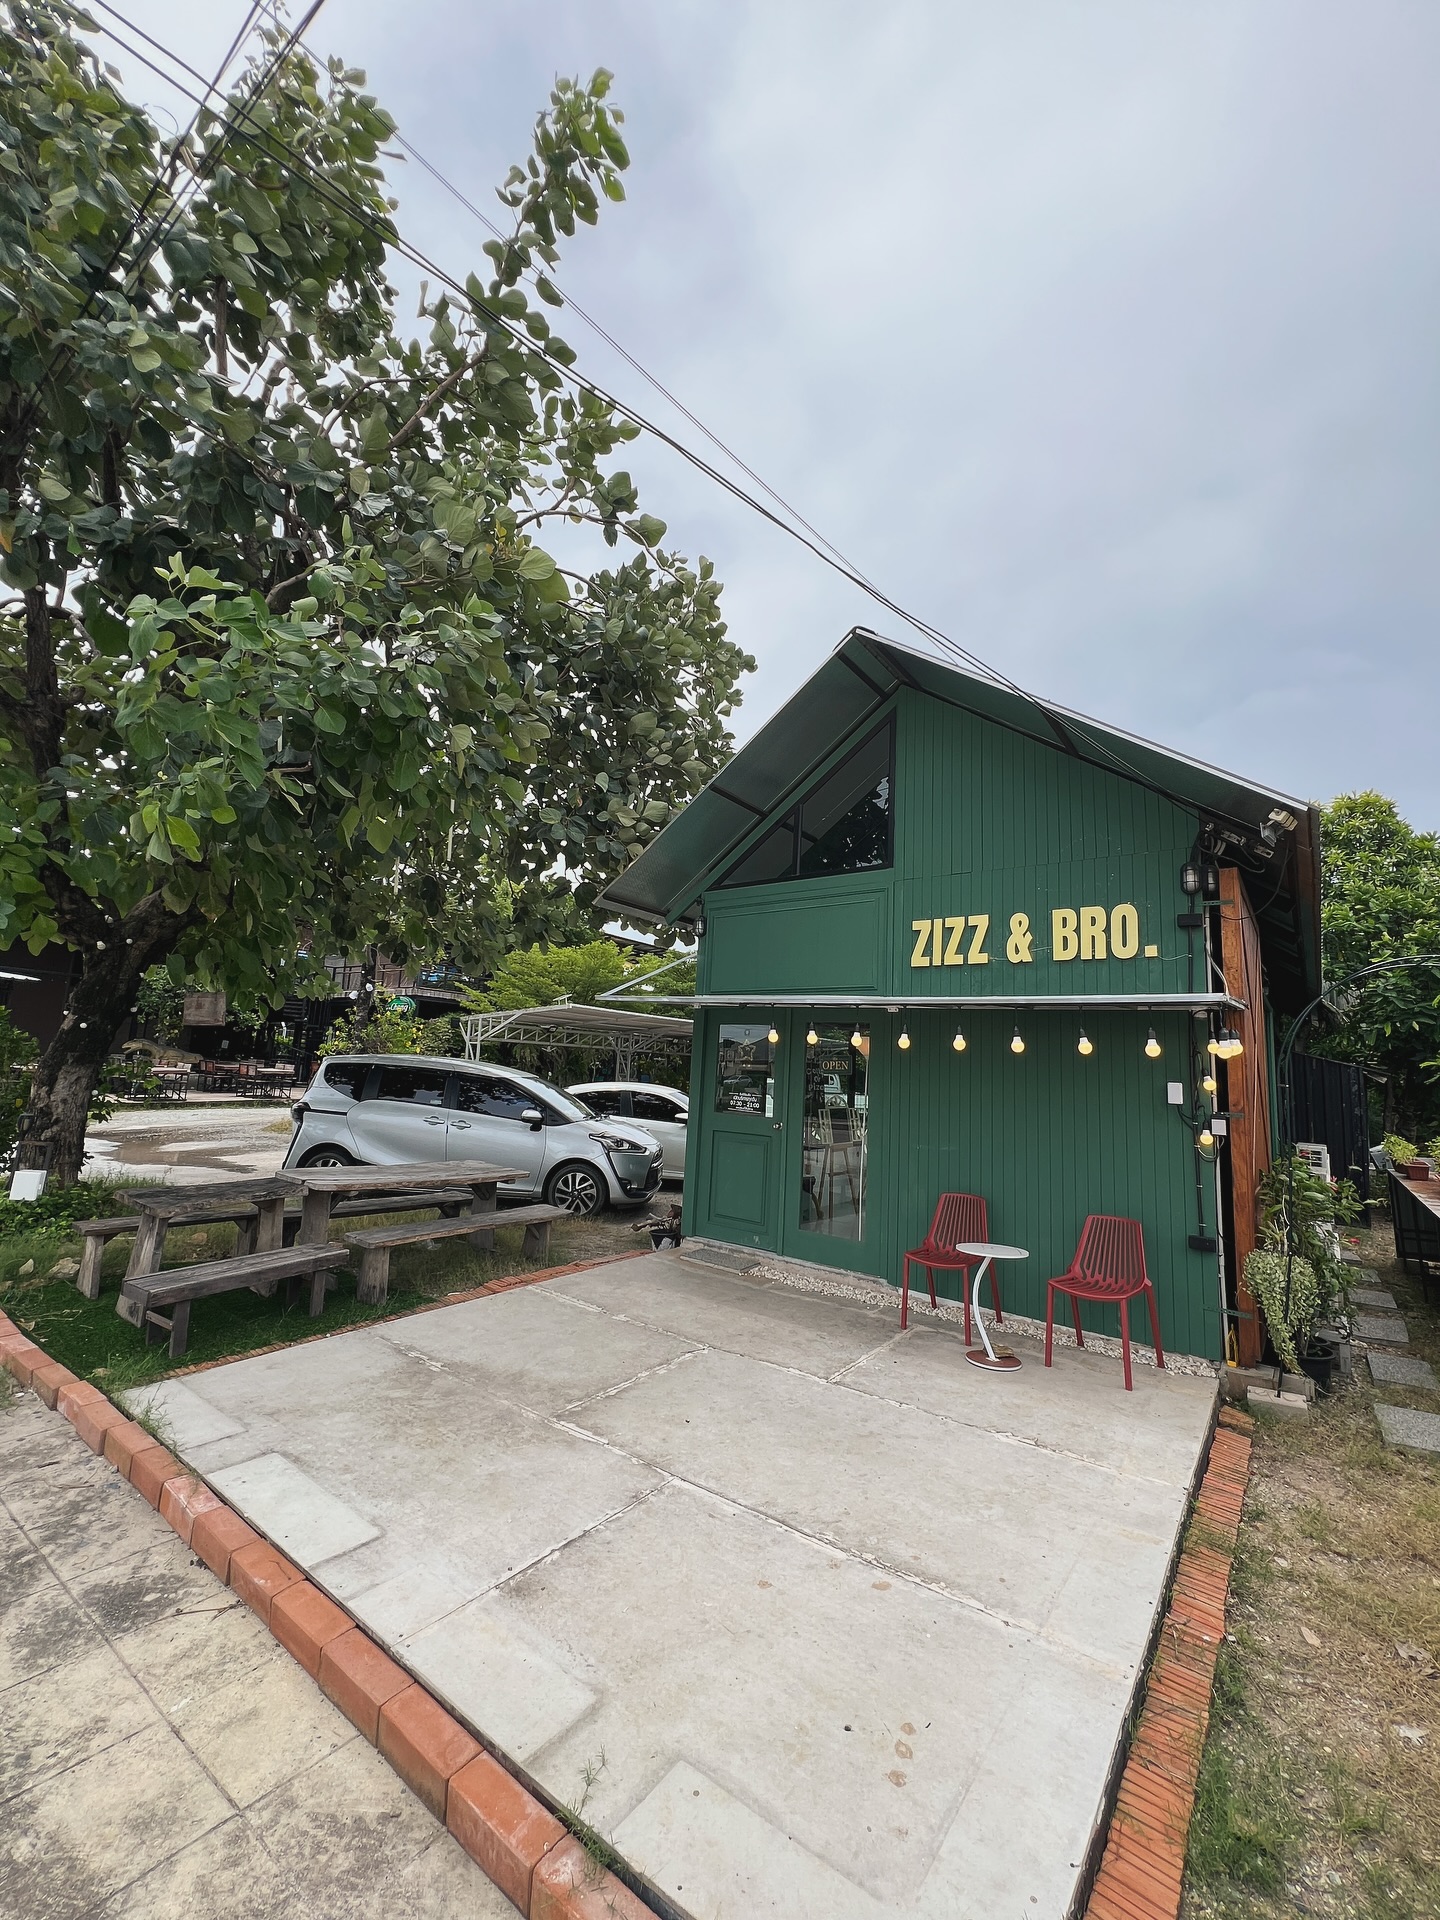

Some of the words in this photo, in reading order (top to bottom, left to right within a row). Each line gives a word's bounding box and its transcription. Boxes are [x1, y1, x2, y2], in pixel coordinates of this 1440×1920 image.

[910, 914, 990, 968] ZIZZ
[1006, 912, 1033, 964] &
[1052, 903, 1159, 962] BRO.
[822, 1060, 849, 1070] OPEN
